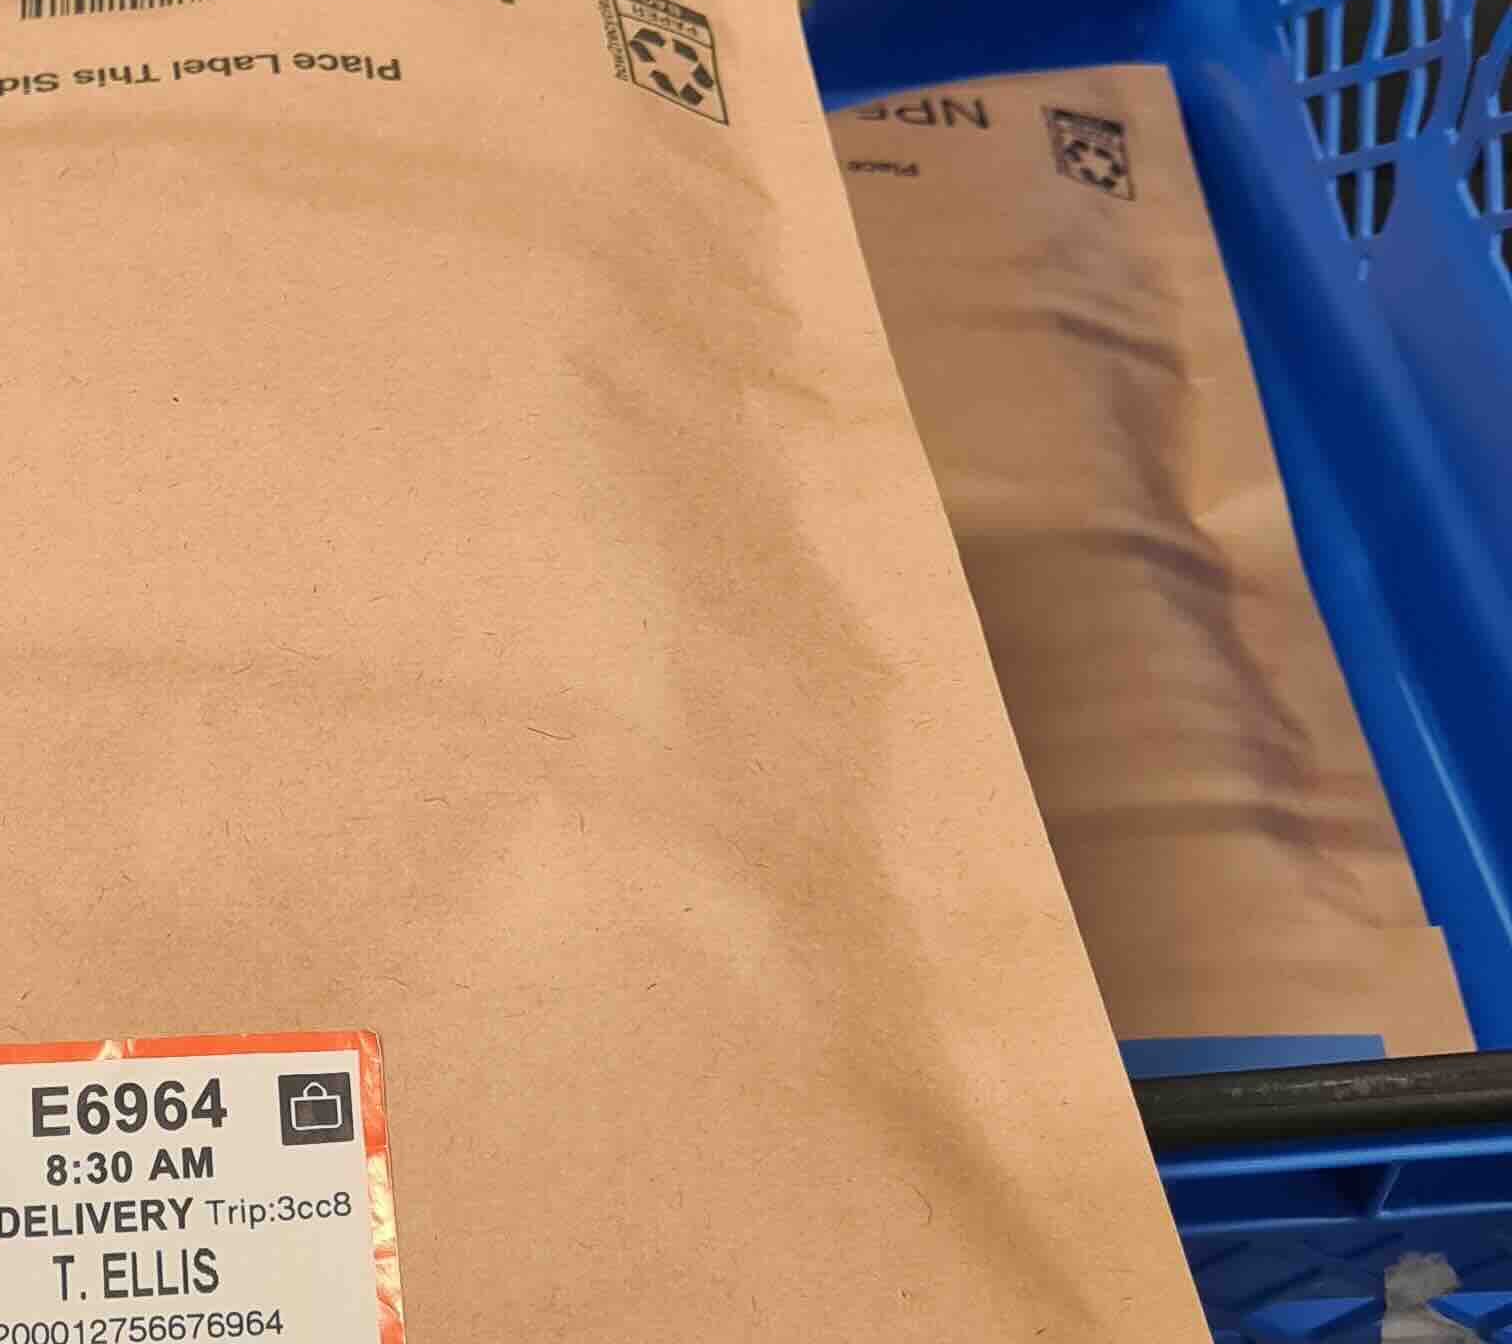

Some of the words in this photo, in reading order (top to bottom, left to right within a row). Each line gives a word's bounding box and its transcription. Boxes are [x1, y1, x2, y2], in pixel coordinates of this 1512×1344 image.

[73, 63, 160, 88] This
[173, 54, 282, 82] Label
[293, 51, 402, 82] Place
[31, 1078, 228, 1138] E6964
[45, 1151, 134, 1186] 8:30
[148, 1146, 215, 1181] AM
[205, 1191, 353, 1229] Trip:3cc8
[52, 1255, 87, 1301] T.
[102, 1247, 220, 1299] ELLIS
